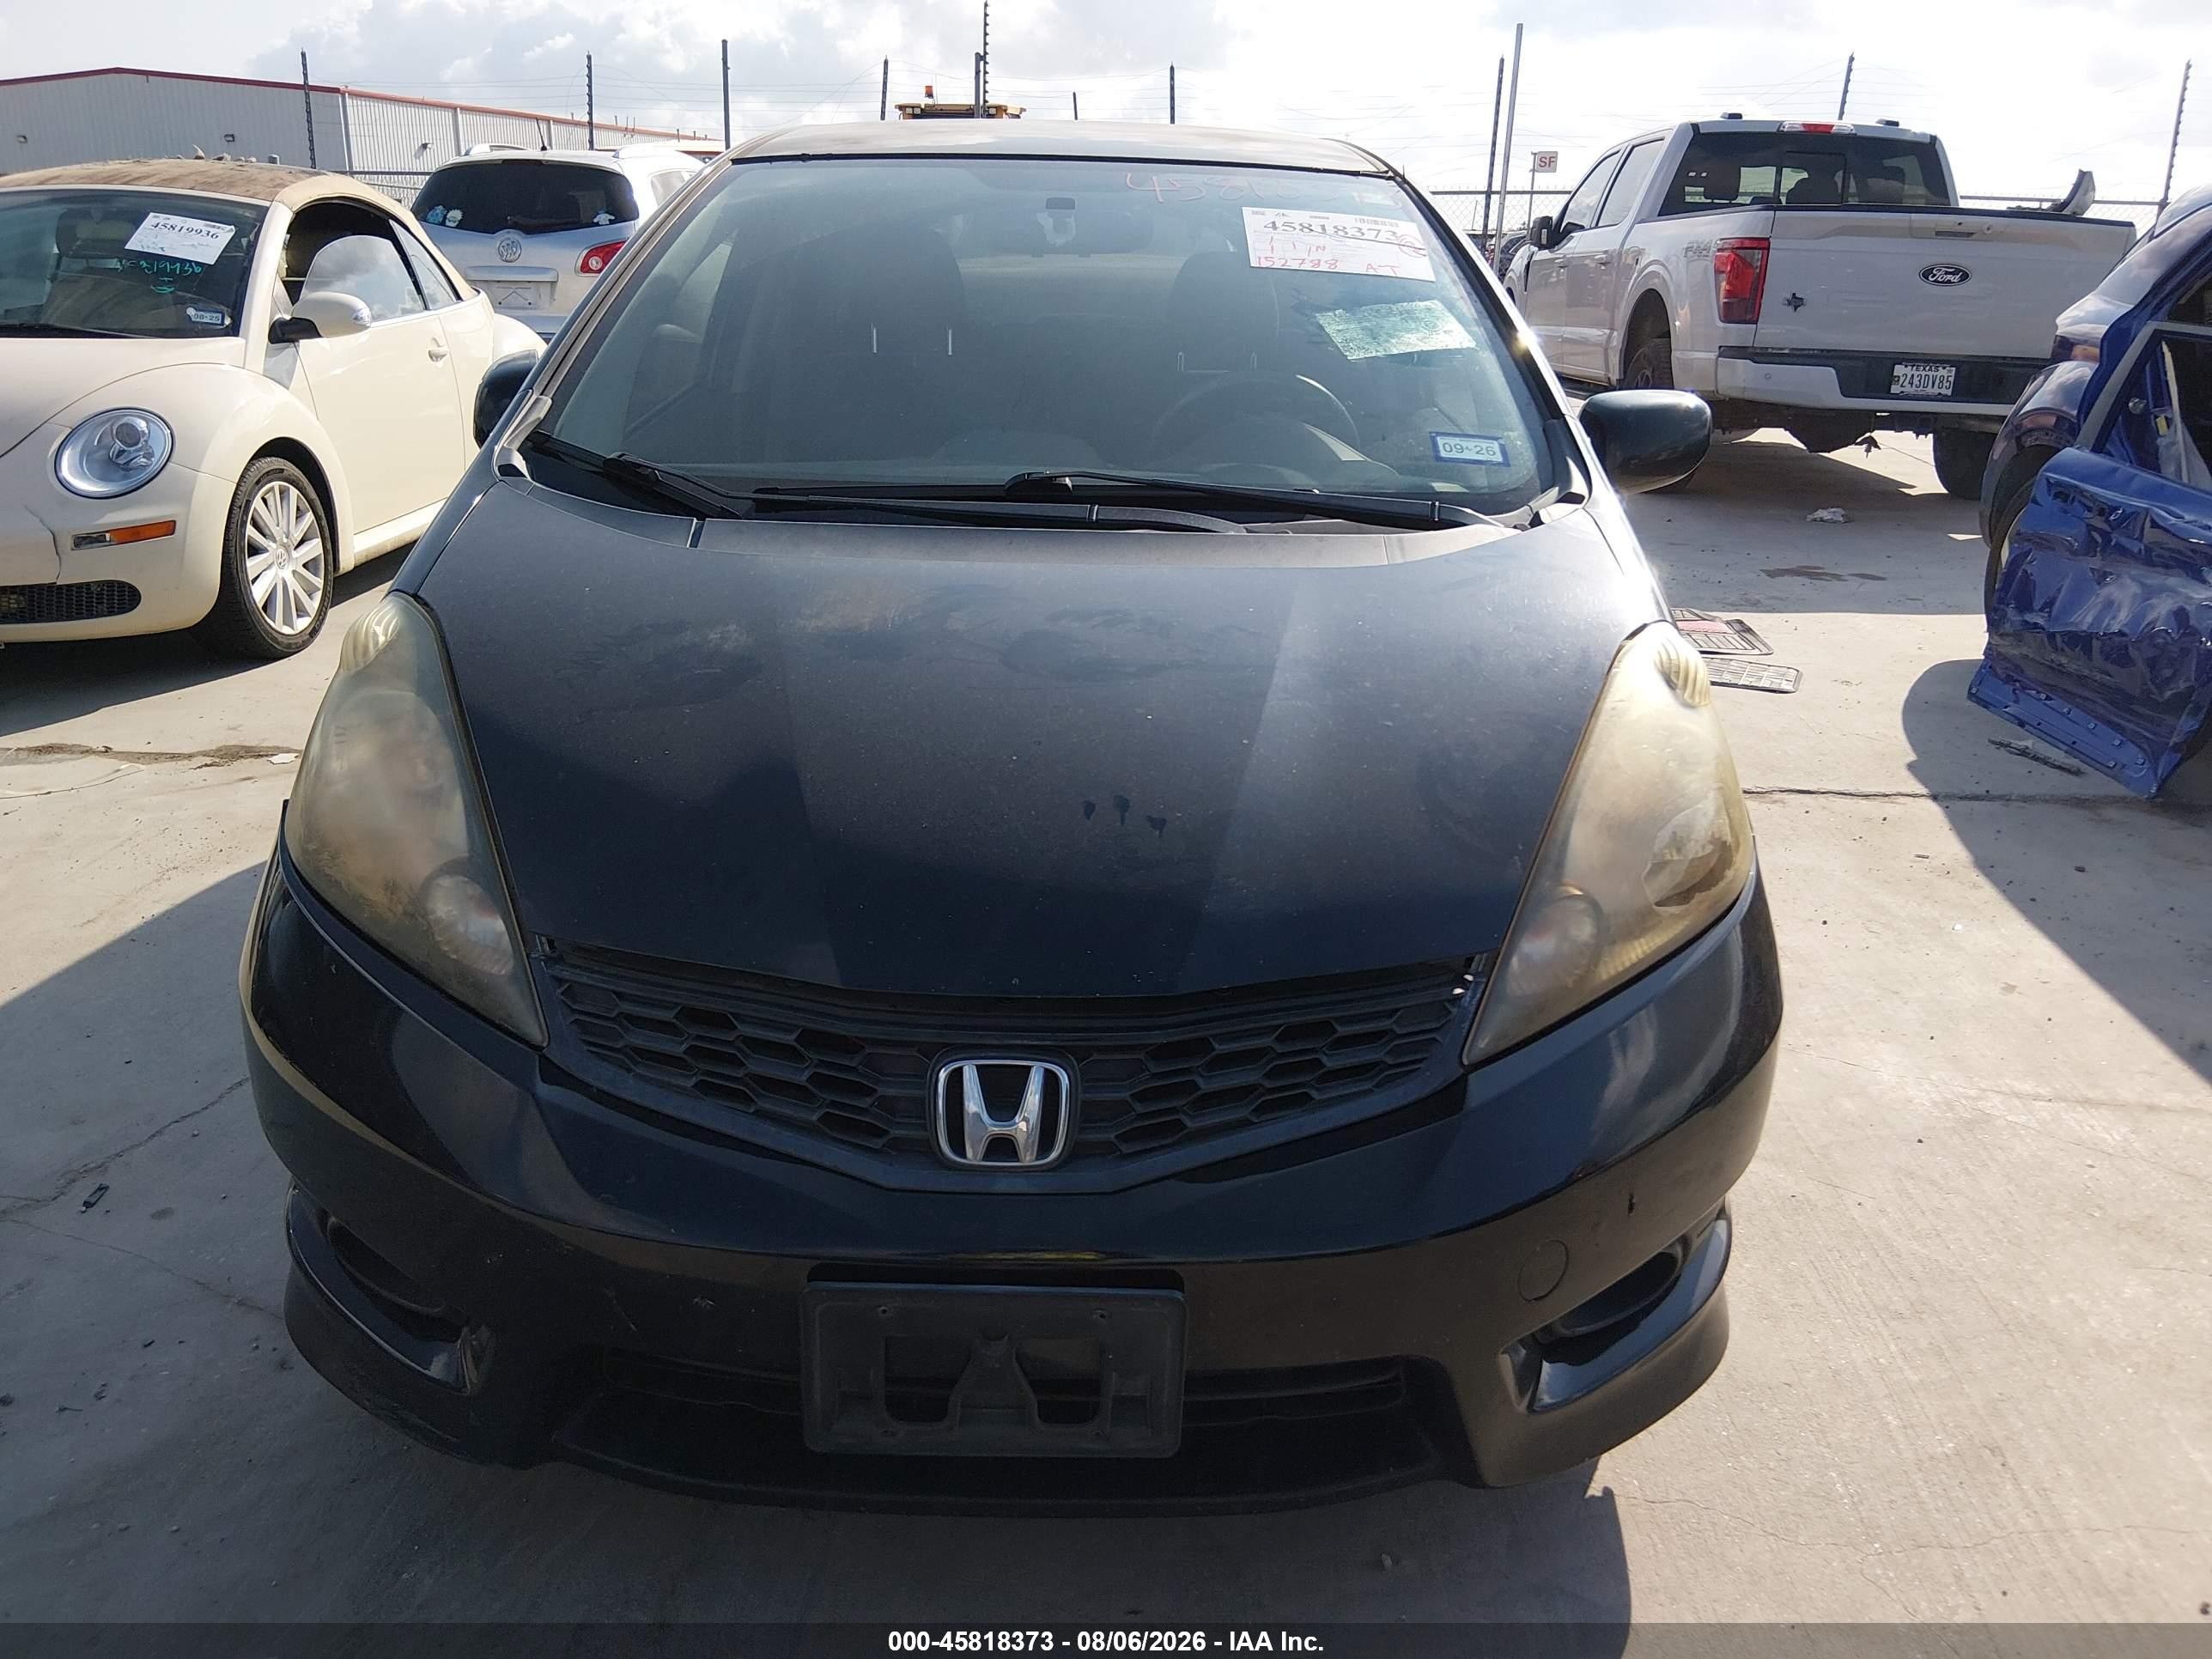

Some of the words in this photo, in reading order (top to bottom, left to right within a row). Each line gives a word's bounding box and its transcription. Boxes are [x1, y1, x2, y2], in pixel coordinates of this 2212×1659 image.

[1538, 156, 1556, 167] SF
[150, 222, 220, 240] 45819936
[1263, 220, 1398, 240] 45818373
[1928, 266, 1964, 283] Ford
[1911, 364, 1940, 373] TEXAS
[1899, 373, 1954, 390] 243DV85
